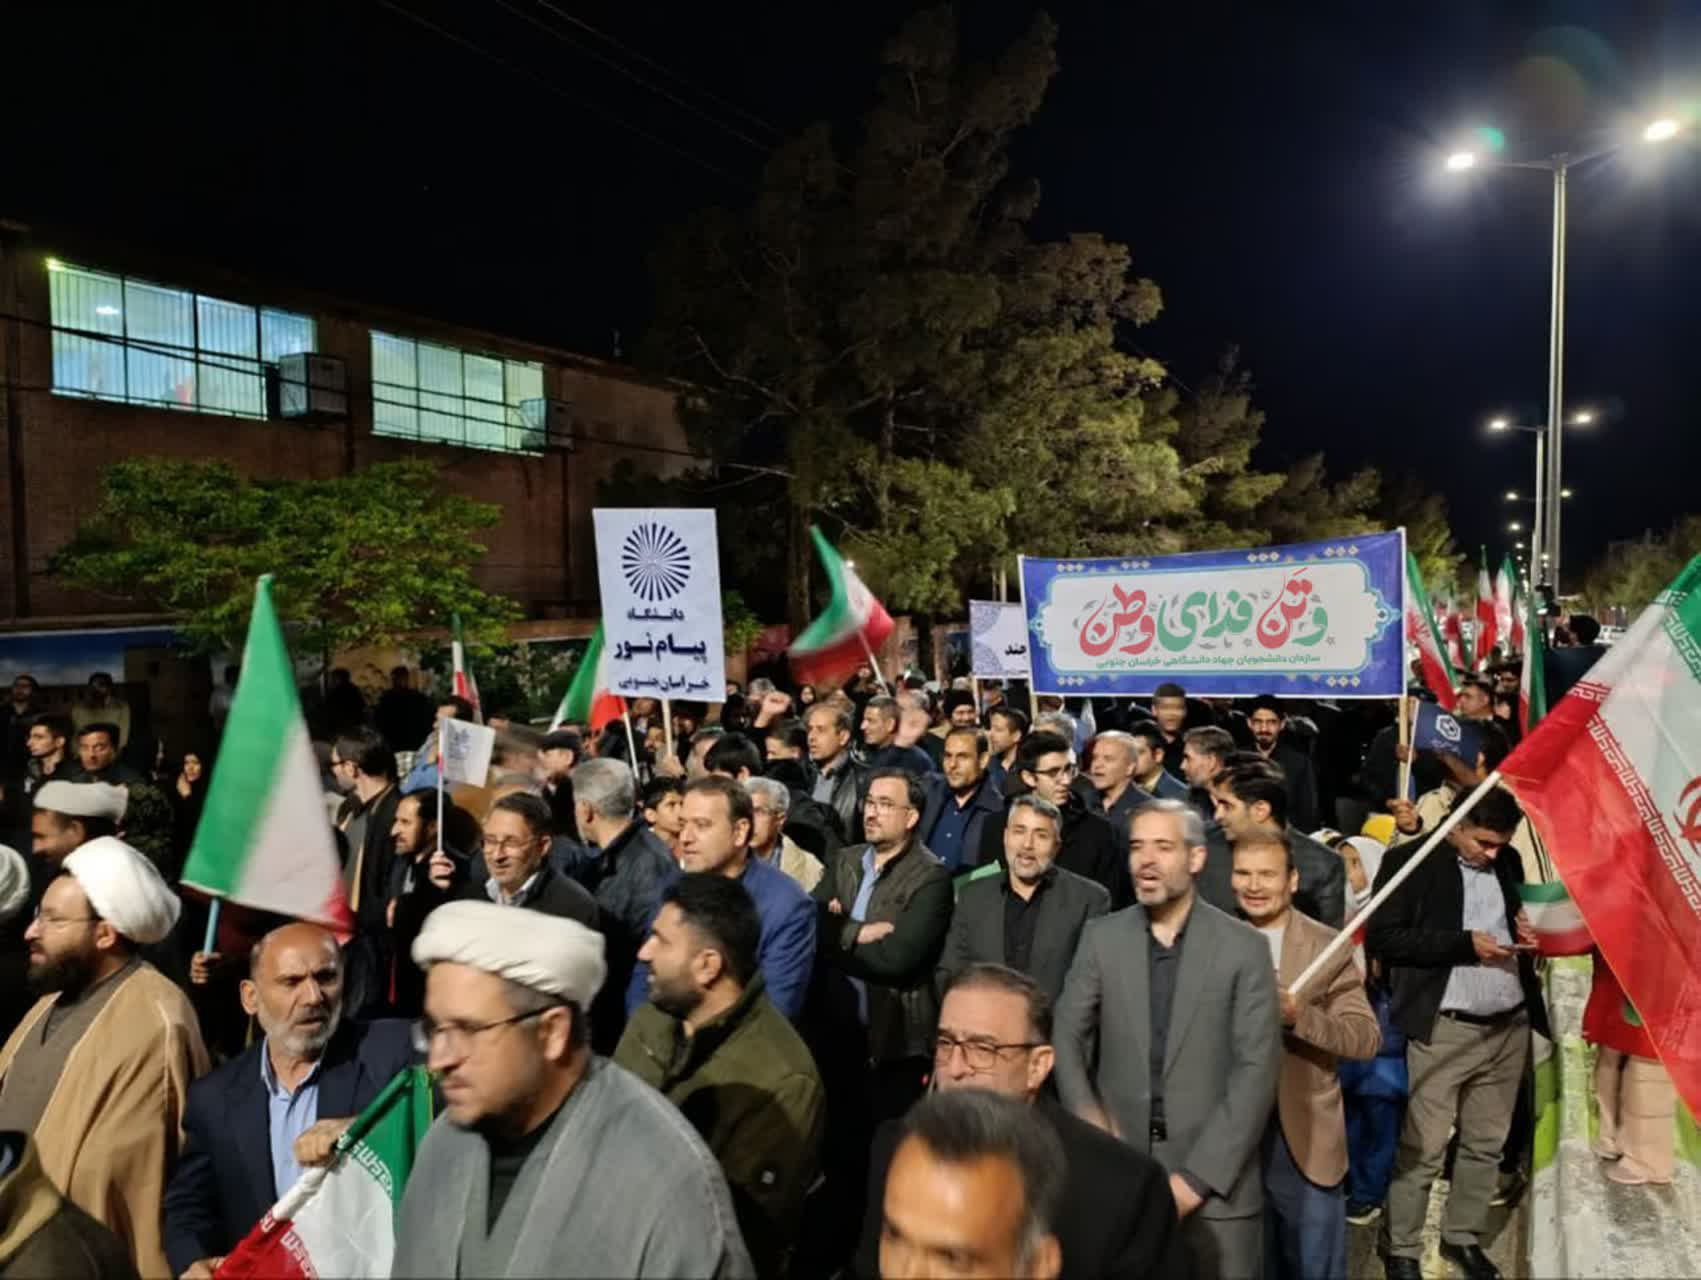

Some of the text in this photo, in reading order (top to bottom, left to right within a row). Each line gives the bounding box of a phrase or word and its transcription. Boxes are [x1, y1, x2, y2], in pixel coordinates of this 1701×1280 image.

[627, 607, 684, 621] دانشگاه
[1080, 583, 1155, 657] وطن
[1157, 589, 1253, 652] فدای
[614, 632, 707, 664] پیام نور
[1095, 653, 1320, 669] سازمان دانشجویان جهاد دانشگاهی خراسان جنوبی
[618, 674, 709, 693] خراسان جنوبی
